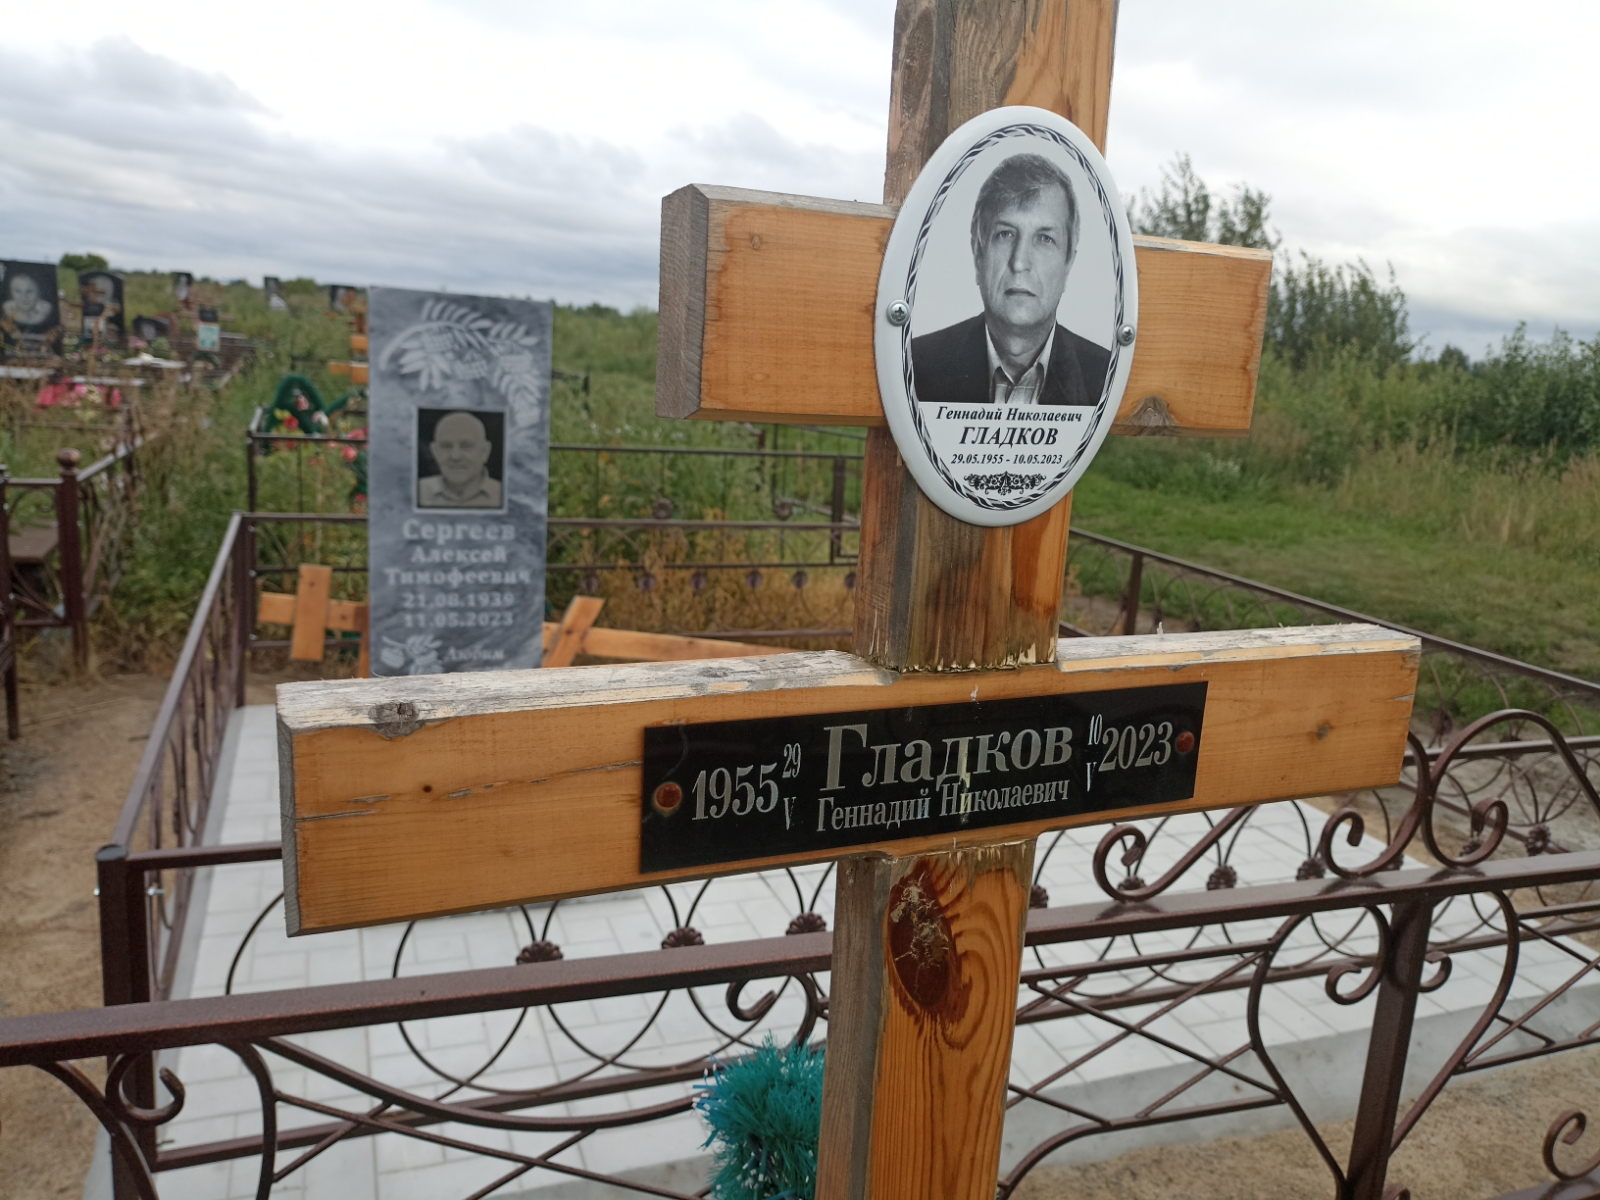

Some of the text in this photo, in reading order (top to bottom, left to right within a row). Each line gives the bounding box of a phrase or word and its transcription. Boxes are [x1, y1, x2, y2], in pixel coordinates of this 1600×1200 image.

[936, 405, 1082, 422] Геннадий Николаевич
[959, 426, 1059, 448] ГЛАДКОВ
[950, 453, 1004, 465] 29.05.1955
[1012, 453, 1063, 465] 10.05.2023
[402, 518, 516, 545] Сергеев
[410, 545, 507, 563] Алексей
[384, 567, 532, 588] Тимофеевич
[404, 611, 514, 629] 11.05.2023
[691, 762, 779, 821] 1955
[782, 742, 801, 779] 29
[819, 723, 1073, 792] Гладков
[1087, 713, 1103, 746] 10
[1098, 721, 1173, 772] 2023
[816, 779, 1070, 832] Геннадий Николаевич
